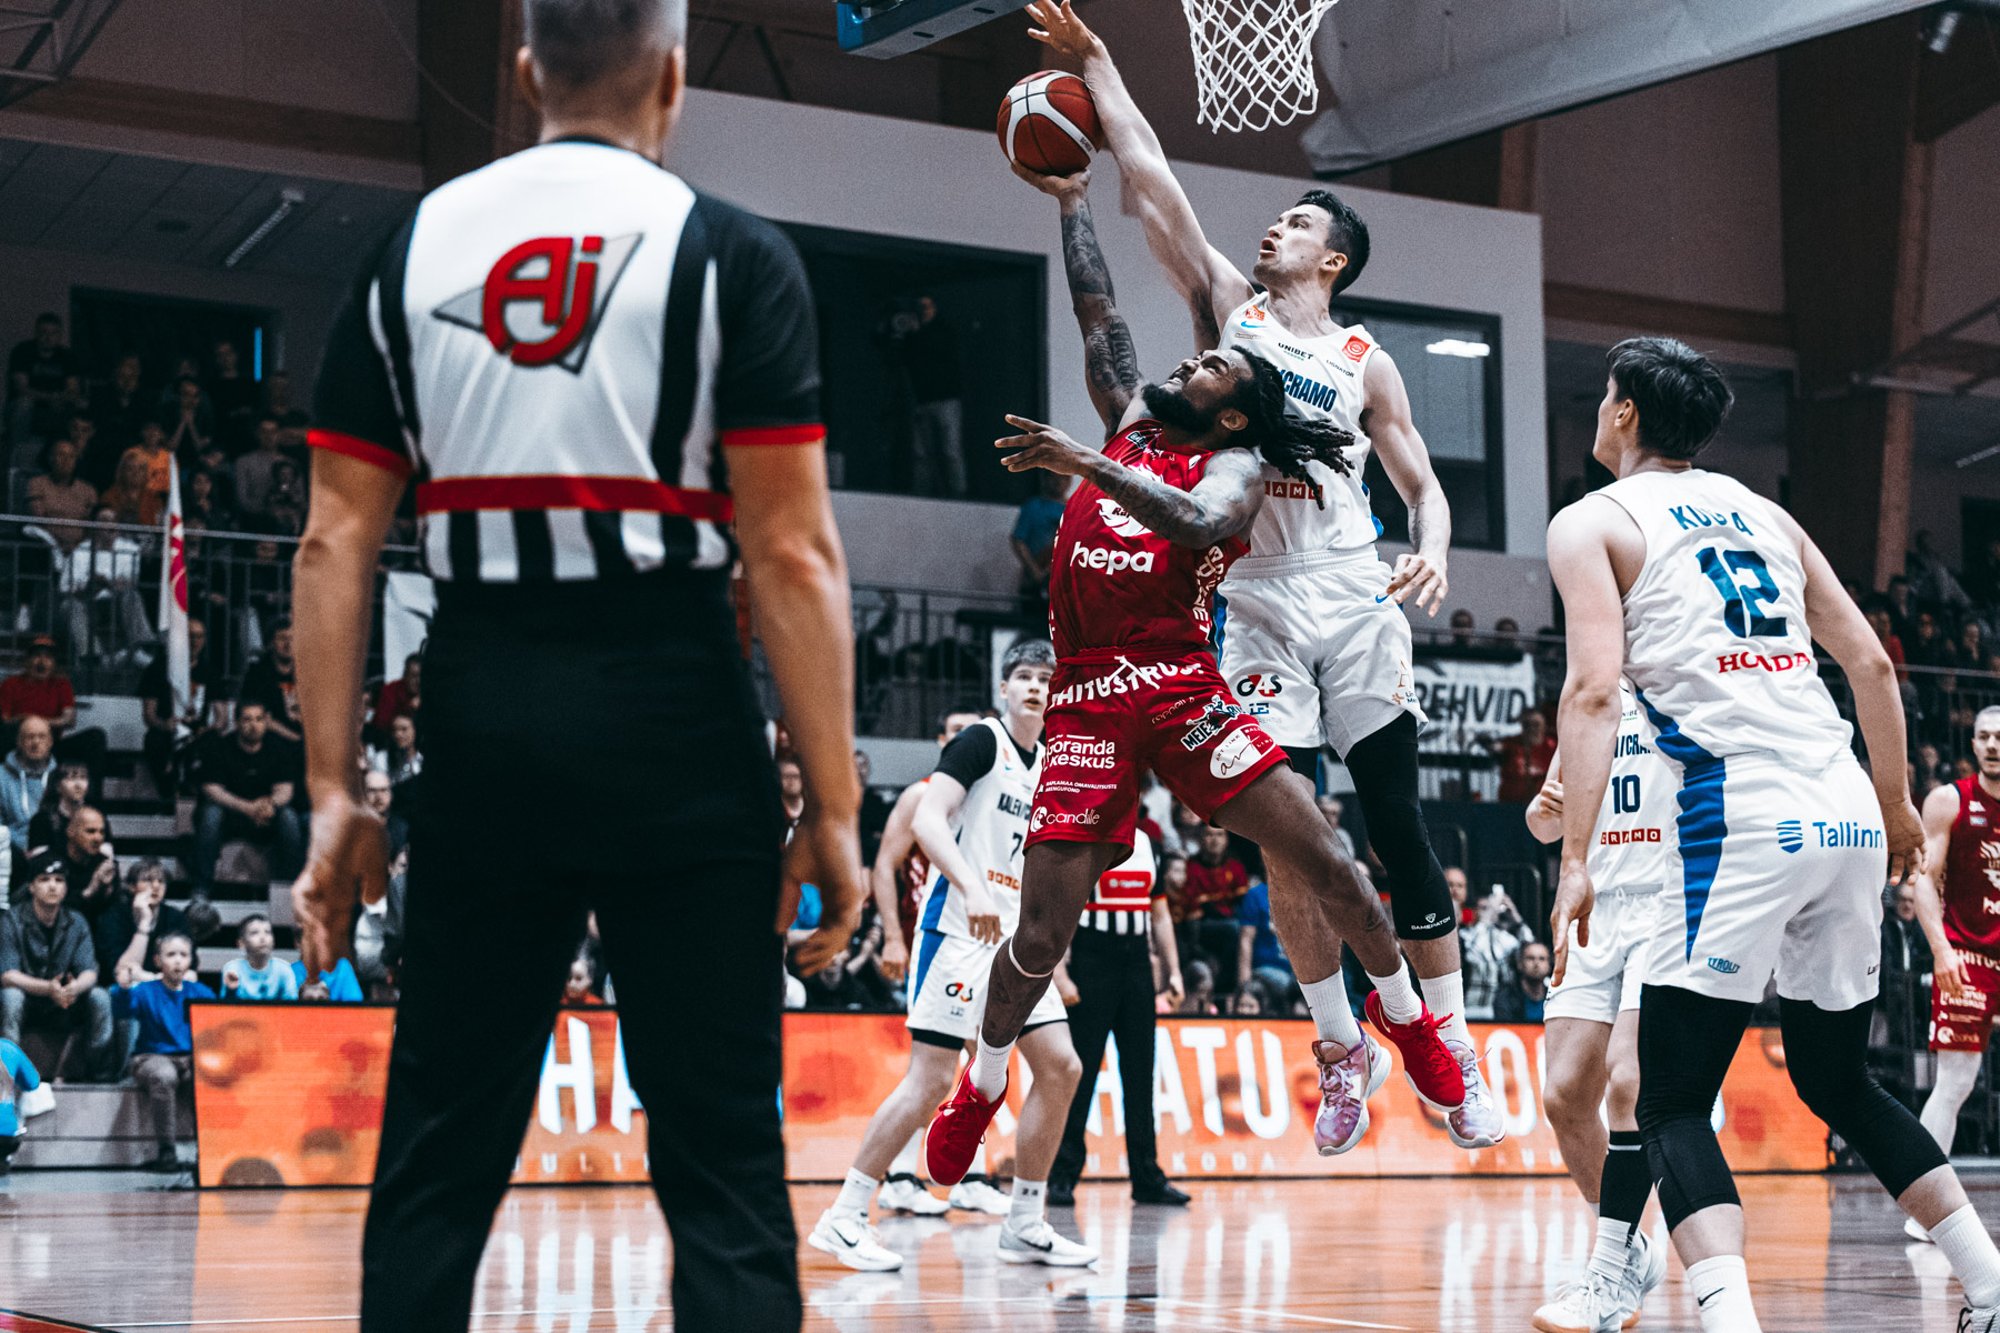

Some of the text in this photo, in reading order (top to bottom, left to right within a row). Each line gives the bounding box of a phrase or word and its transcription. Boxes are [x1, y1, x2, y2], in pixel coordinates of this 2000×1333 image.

[1278, 342, 1314, 360] UNIBET
[1070, 541, 1155, 575] hepa
[1695, 546, 1789, 639] 12
[1237, 674, 1283, 697] G4S
[1611, 774, 1641, 815] 10
[1010, 831, 1023, 862] 7
[1812, 821, 1883, 849] Tallinn
